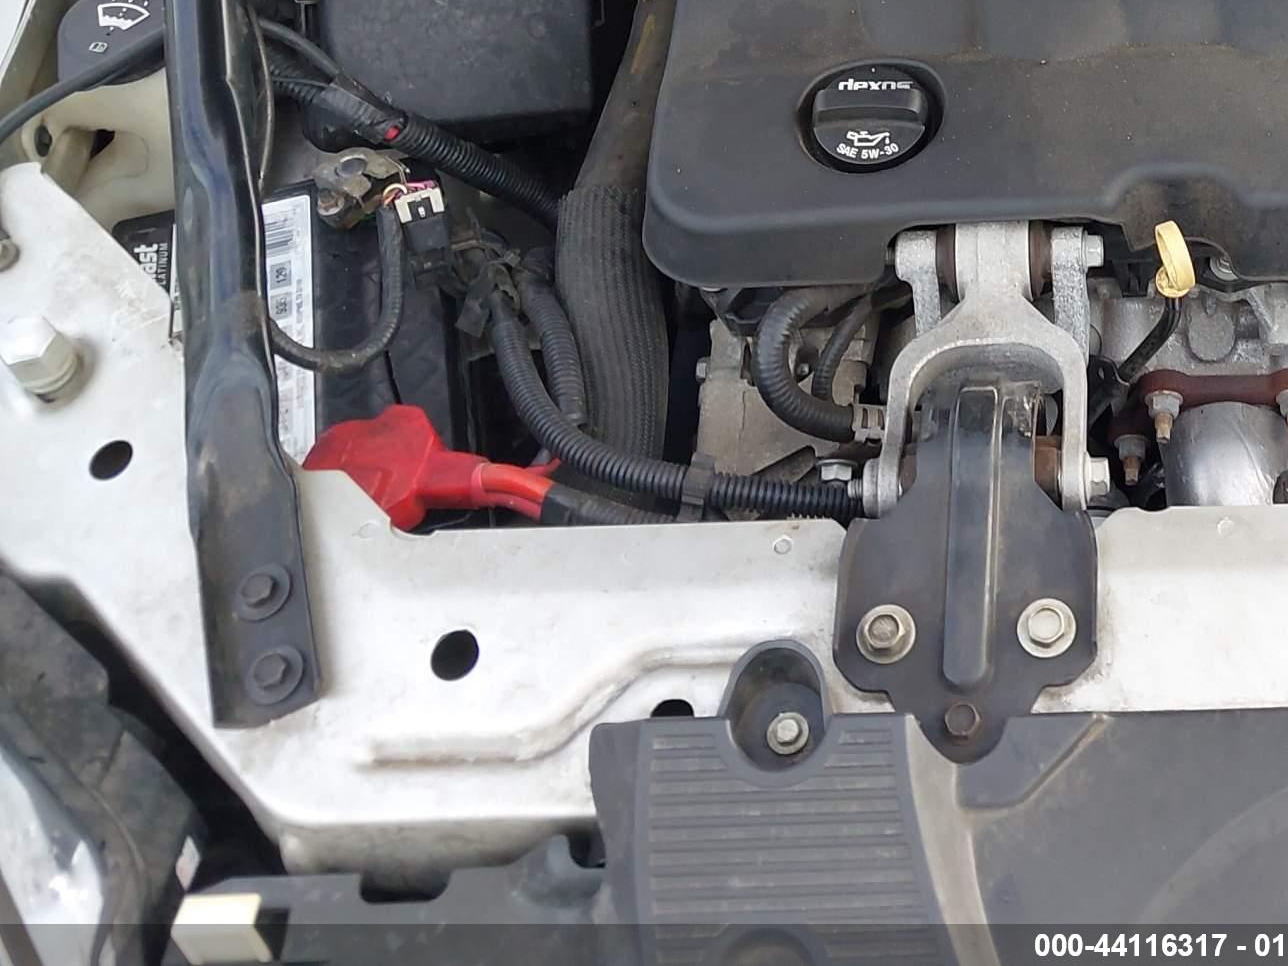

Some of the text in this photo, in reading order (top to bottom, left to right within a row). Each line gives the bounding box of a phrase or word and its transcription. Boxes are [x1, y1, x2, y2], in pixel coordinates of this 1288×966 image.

[836, 142, 899, 159] SAE 5W-30
[134, 243, 158, 280] ast
[158, 242, 168, 285] LATINUM
